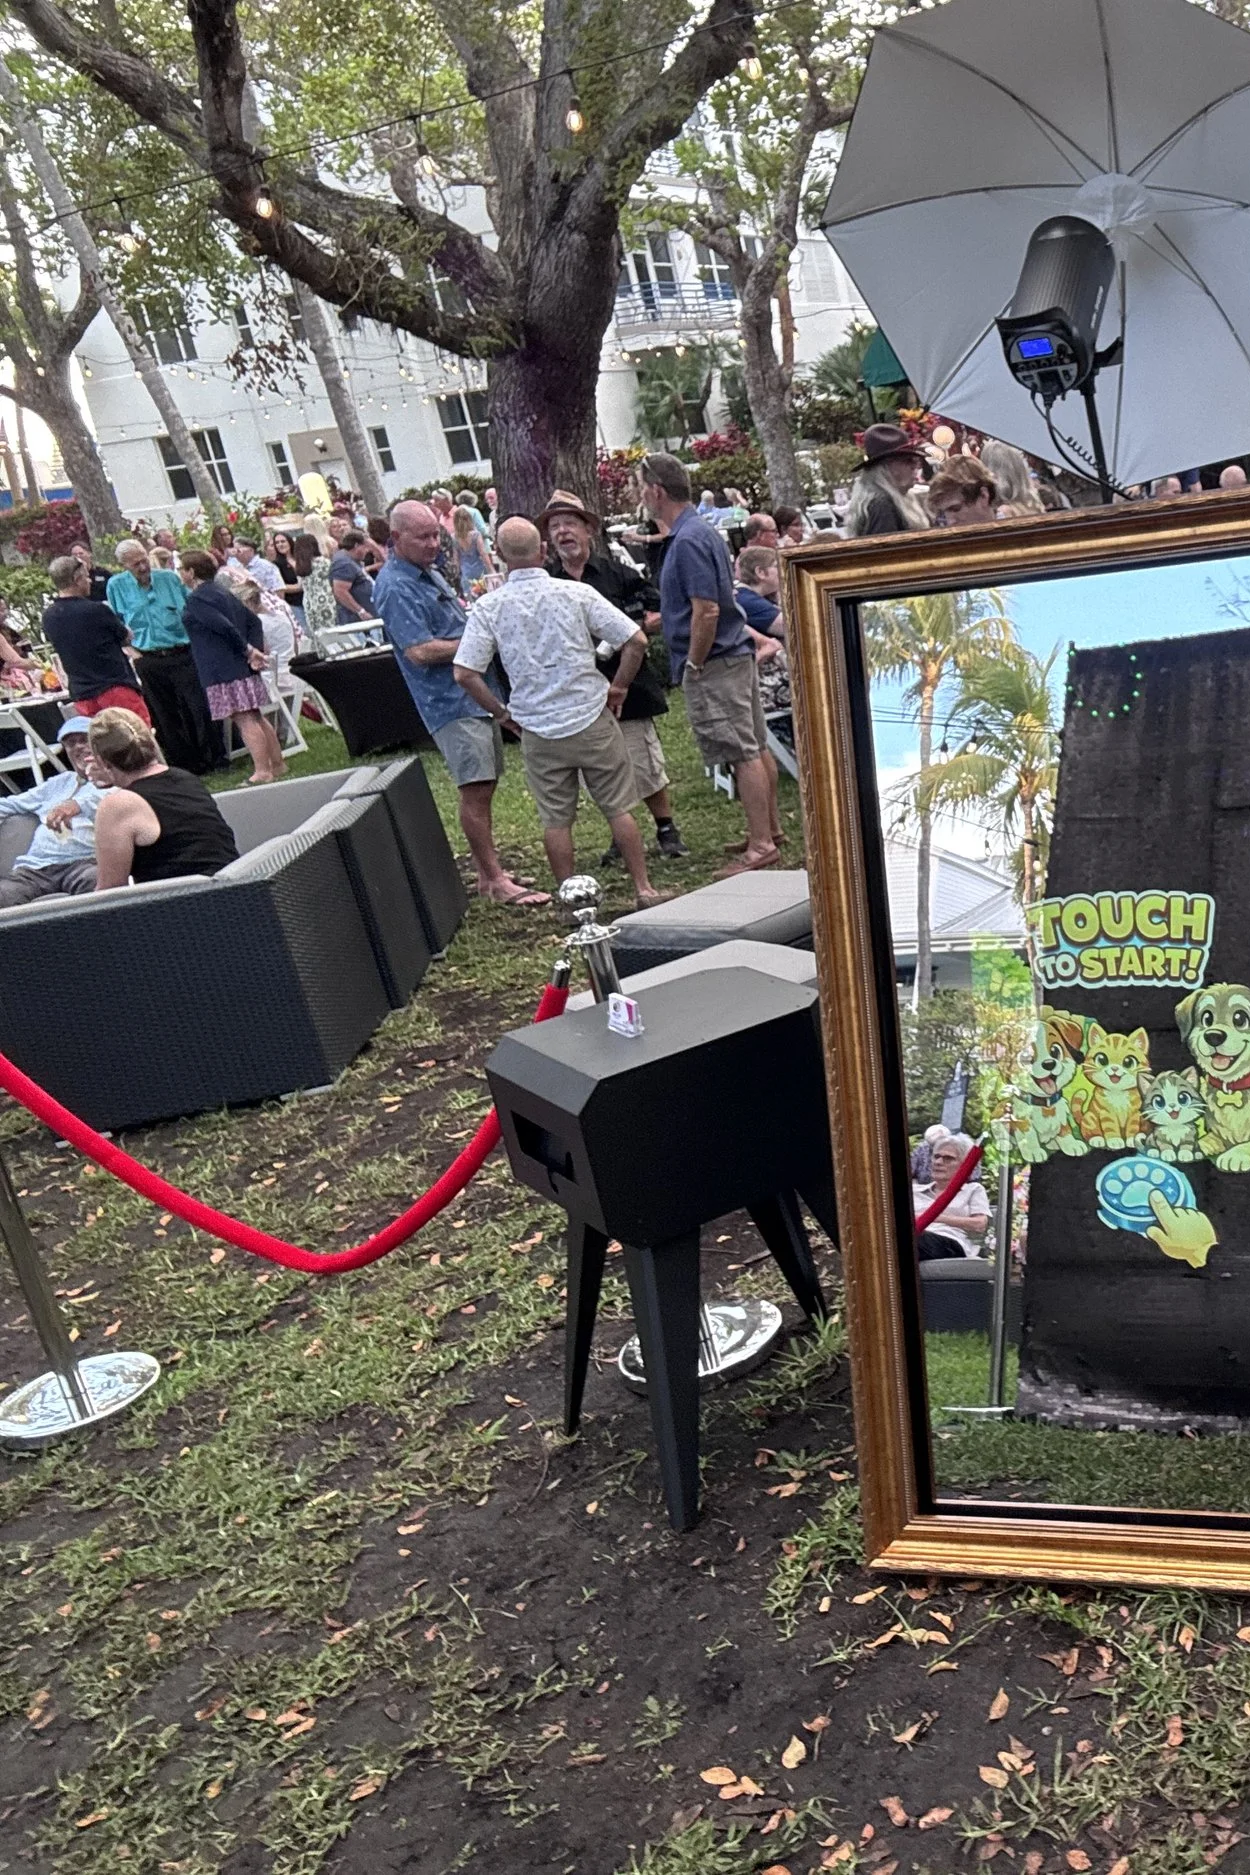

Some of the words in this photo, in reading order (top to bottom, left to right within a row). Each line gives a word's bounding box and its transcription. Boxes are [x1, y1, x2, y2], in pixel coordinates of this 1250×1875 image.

[1026, 893, 1211, 950] TOUCH
[1037, 952, 1077, 981] TO
[1078, 945, 1204, 981] START!
